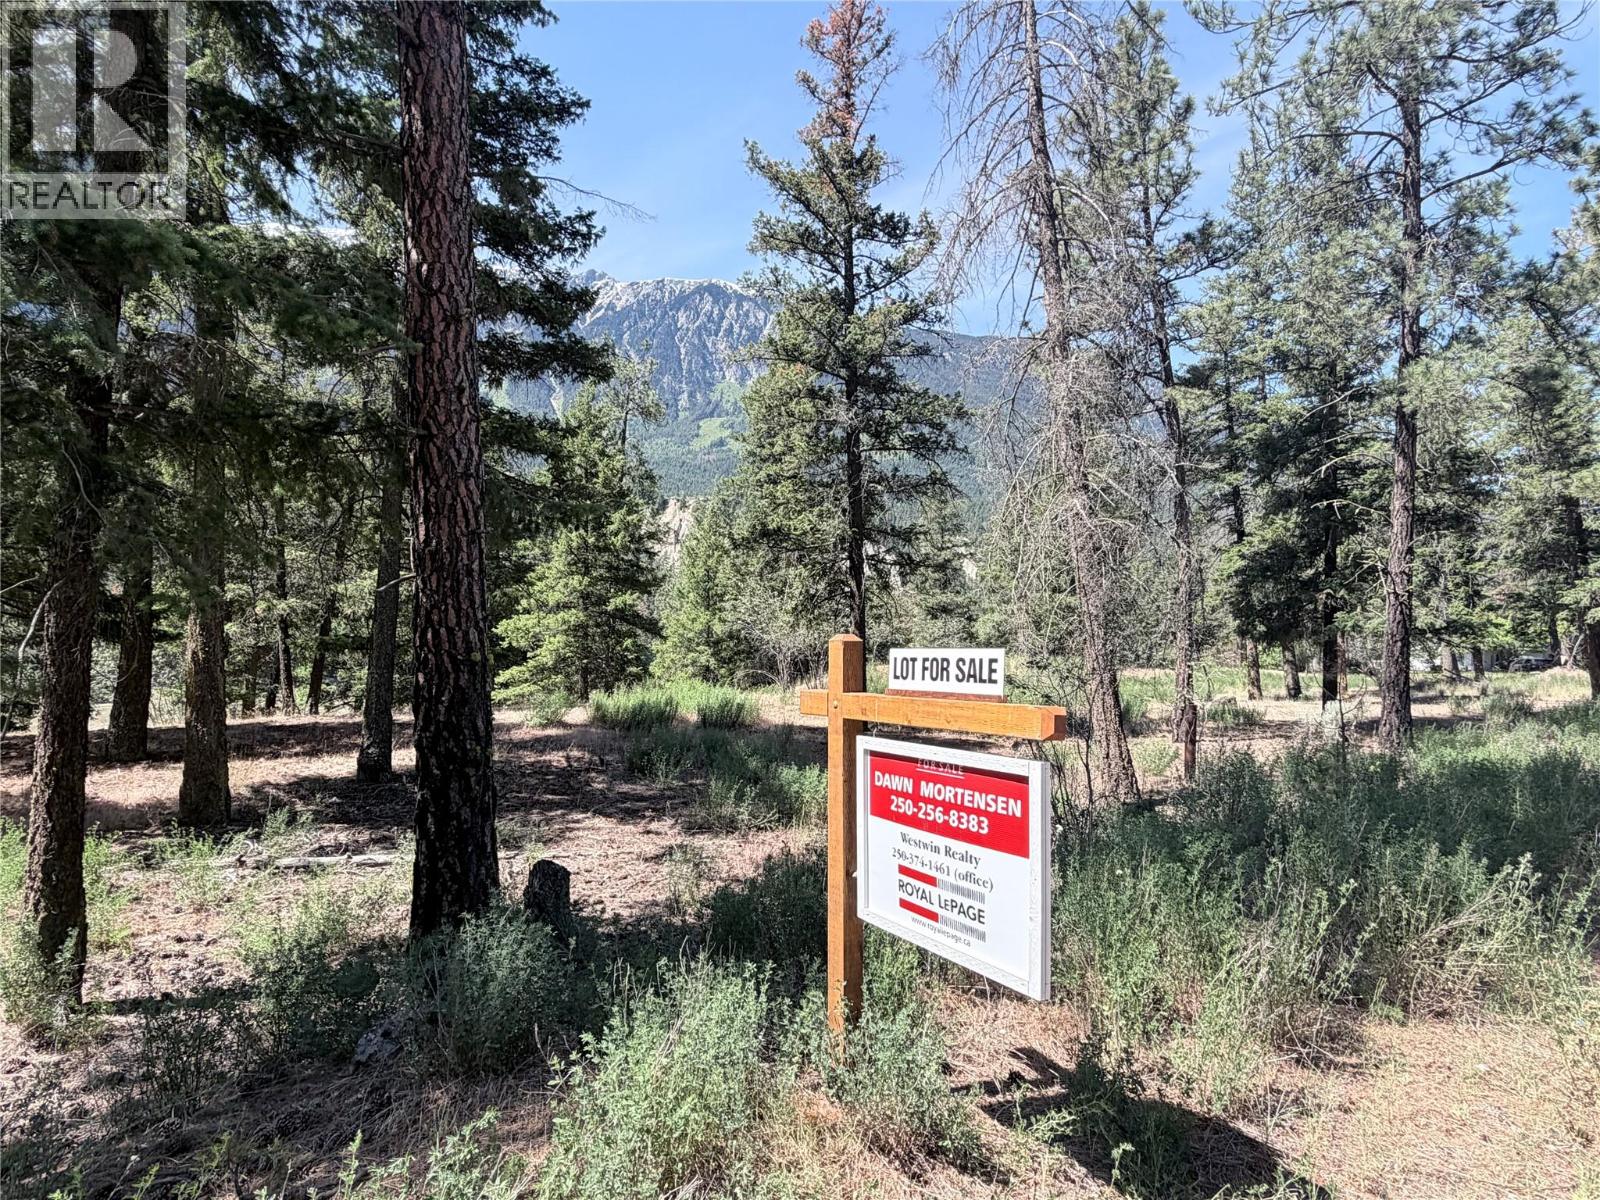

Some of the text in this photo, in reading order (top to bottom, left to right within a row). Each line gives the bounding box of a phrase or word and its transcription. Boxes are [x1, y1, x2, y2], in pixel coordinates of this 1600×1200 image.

[893, 657, 998, 684] LOT FOR SALE
[917, 758, 964, 775] FOR SALE
[874, 771, 1022, 817] DAWN MORTENSEN
[890, 795, 989, 834] 250-256-8383
[900, 831, 981, 869] Westwin Realty
[892, 847, 994, 893] 250-374-1461 (office)
[898, 879, 934, 905] ROYAL
